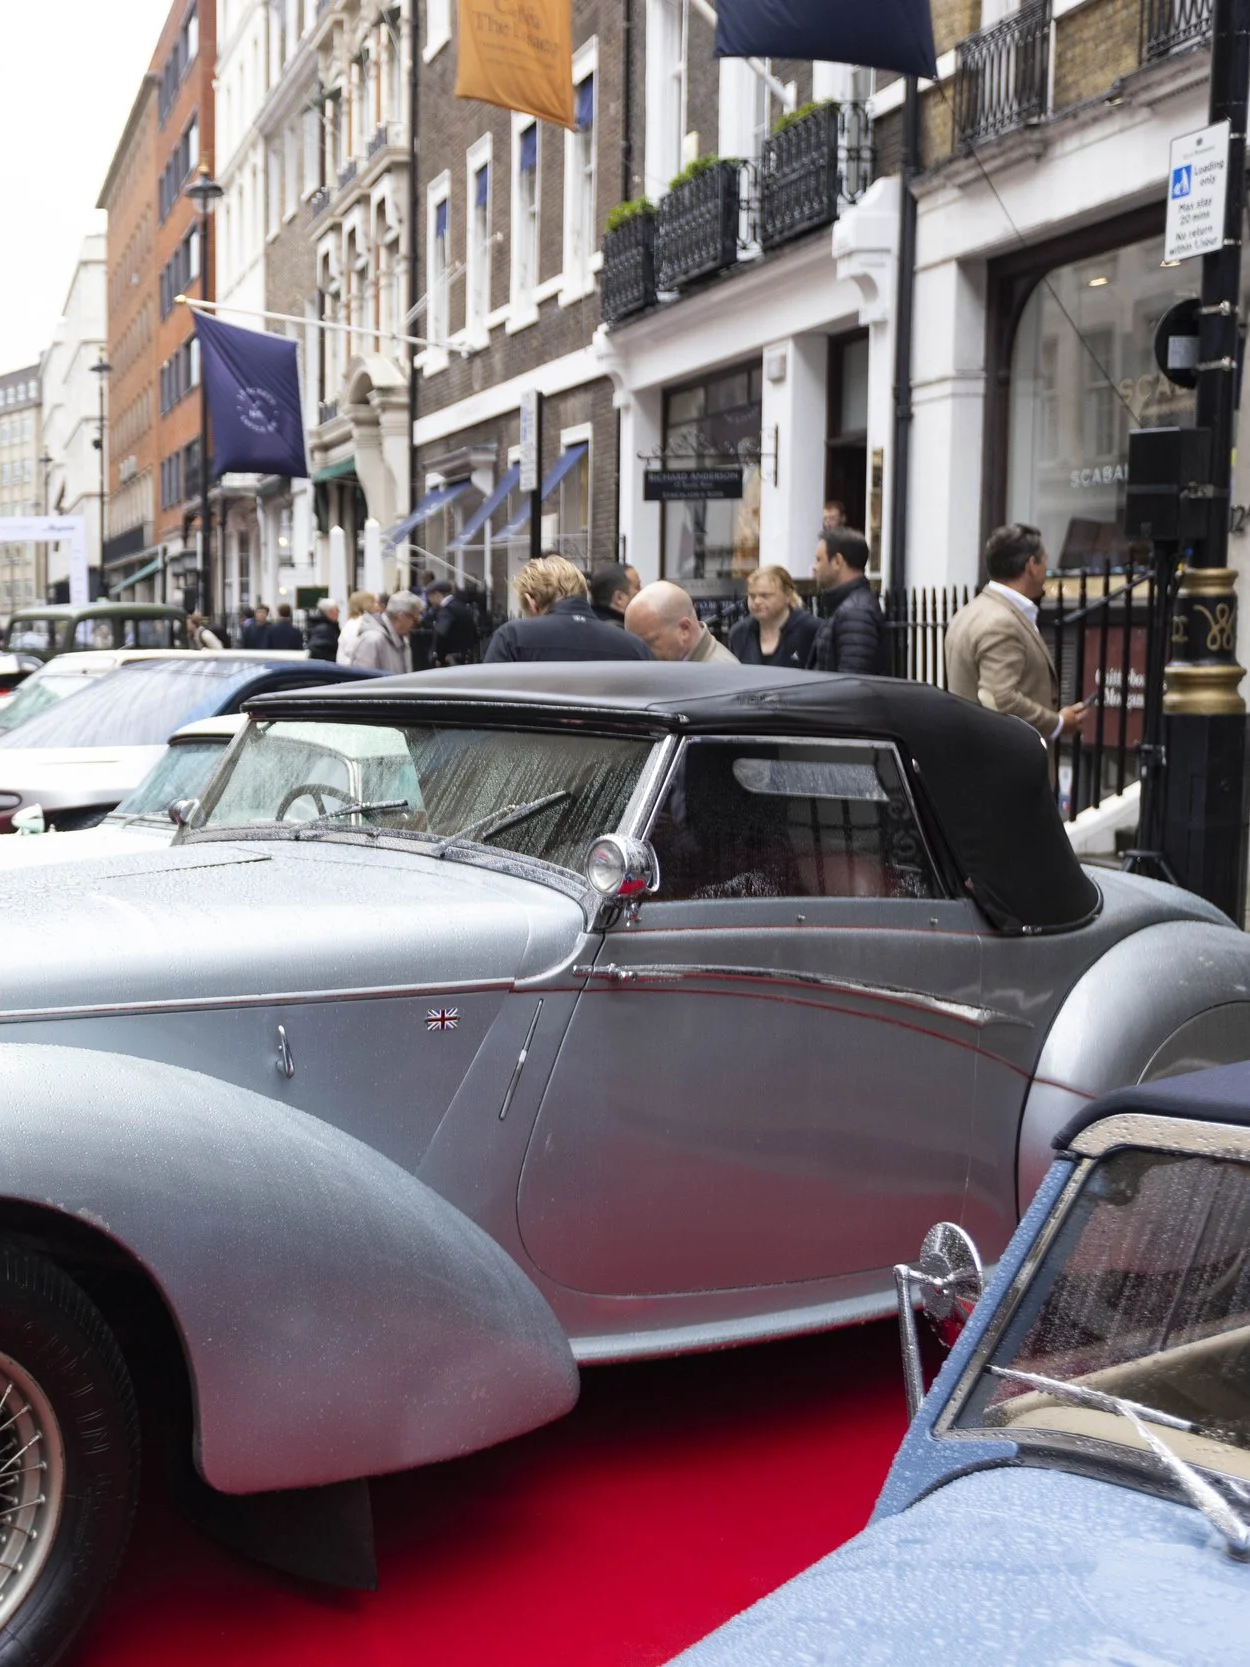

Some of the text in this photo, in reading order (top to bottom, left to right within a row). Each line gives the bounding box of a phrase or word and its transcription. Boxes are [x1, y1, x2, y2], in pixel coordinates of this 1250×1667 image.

[1194, 160, 1224, 176] Loading
[1199, 175, 1216, 187] only
[1196, 198, 1212, 209] stay
[1180, 210, 1210, 226] 20 mins
[1176, 225, 1213, 242] No return
[1170, 243, 1192, 255] within
[648, 470, 738, 482] RICHARD ANDERSON
[1104, 687, 1145, 711] Mogan
